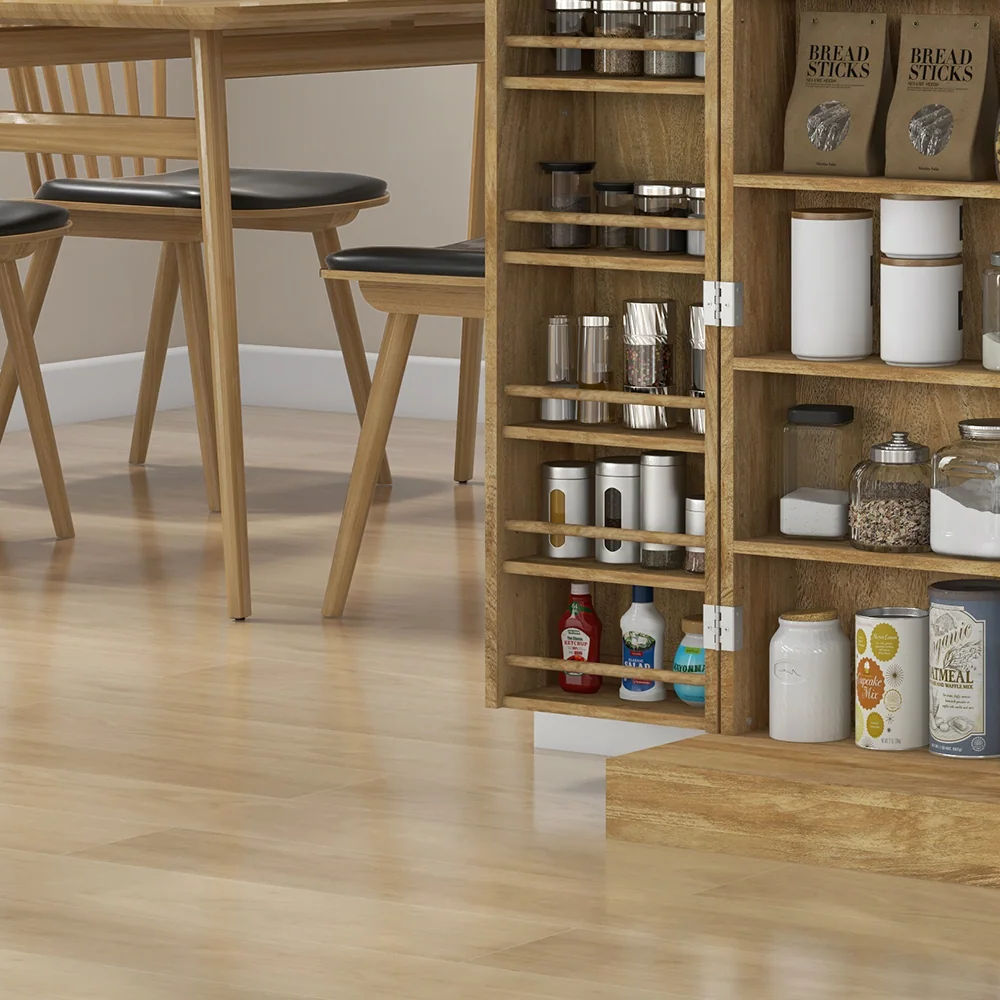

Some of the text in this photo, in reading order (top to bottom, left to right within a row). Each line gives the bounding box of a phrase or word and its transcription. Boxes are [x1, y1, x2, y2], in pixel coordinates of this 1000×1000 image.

[808, 45, 870, 62] BREAD
[909, 47, 973, 66] BREAD
[807, 61, 870, 79] STICKS
[908, 64, 974, 82] STICKS
[932, 622, 972, 665] rganic
[931, 667, 974, 684] ATMEAL
[863, 686, 880, 700] Mix
